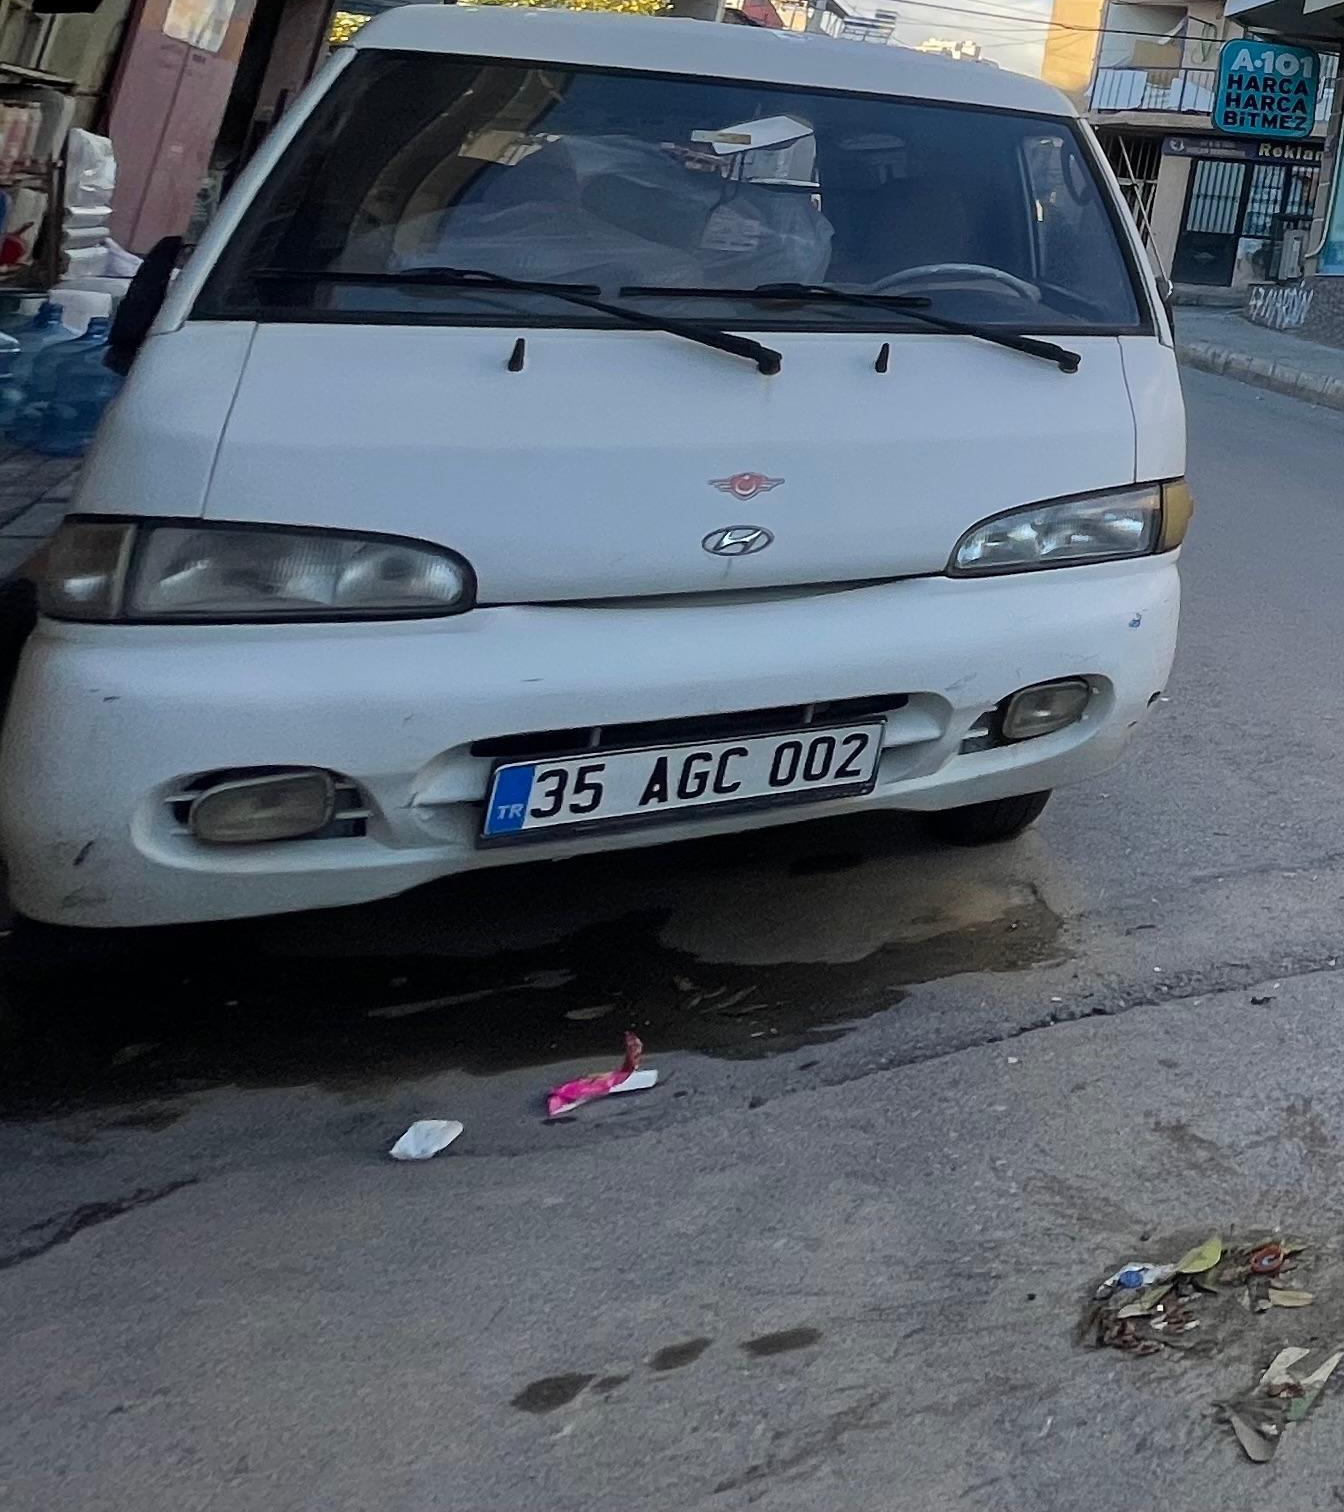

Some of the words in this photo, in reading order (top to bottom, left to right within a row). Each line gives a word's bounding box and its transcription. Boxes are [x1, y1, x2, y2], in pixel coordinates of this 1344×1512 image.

[1227, 73, 1309, 96] HARCA
[1225, 92, 1307, 114] HARCA
[497, 804, 525, 820] TR
[530, 763, 606, 819] 35
[639, 747, 749, 807] AGC
[769, 733, 870, 788] 002
